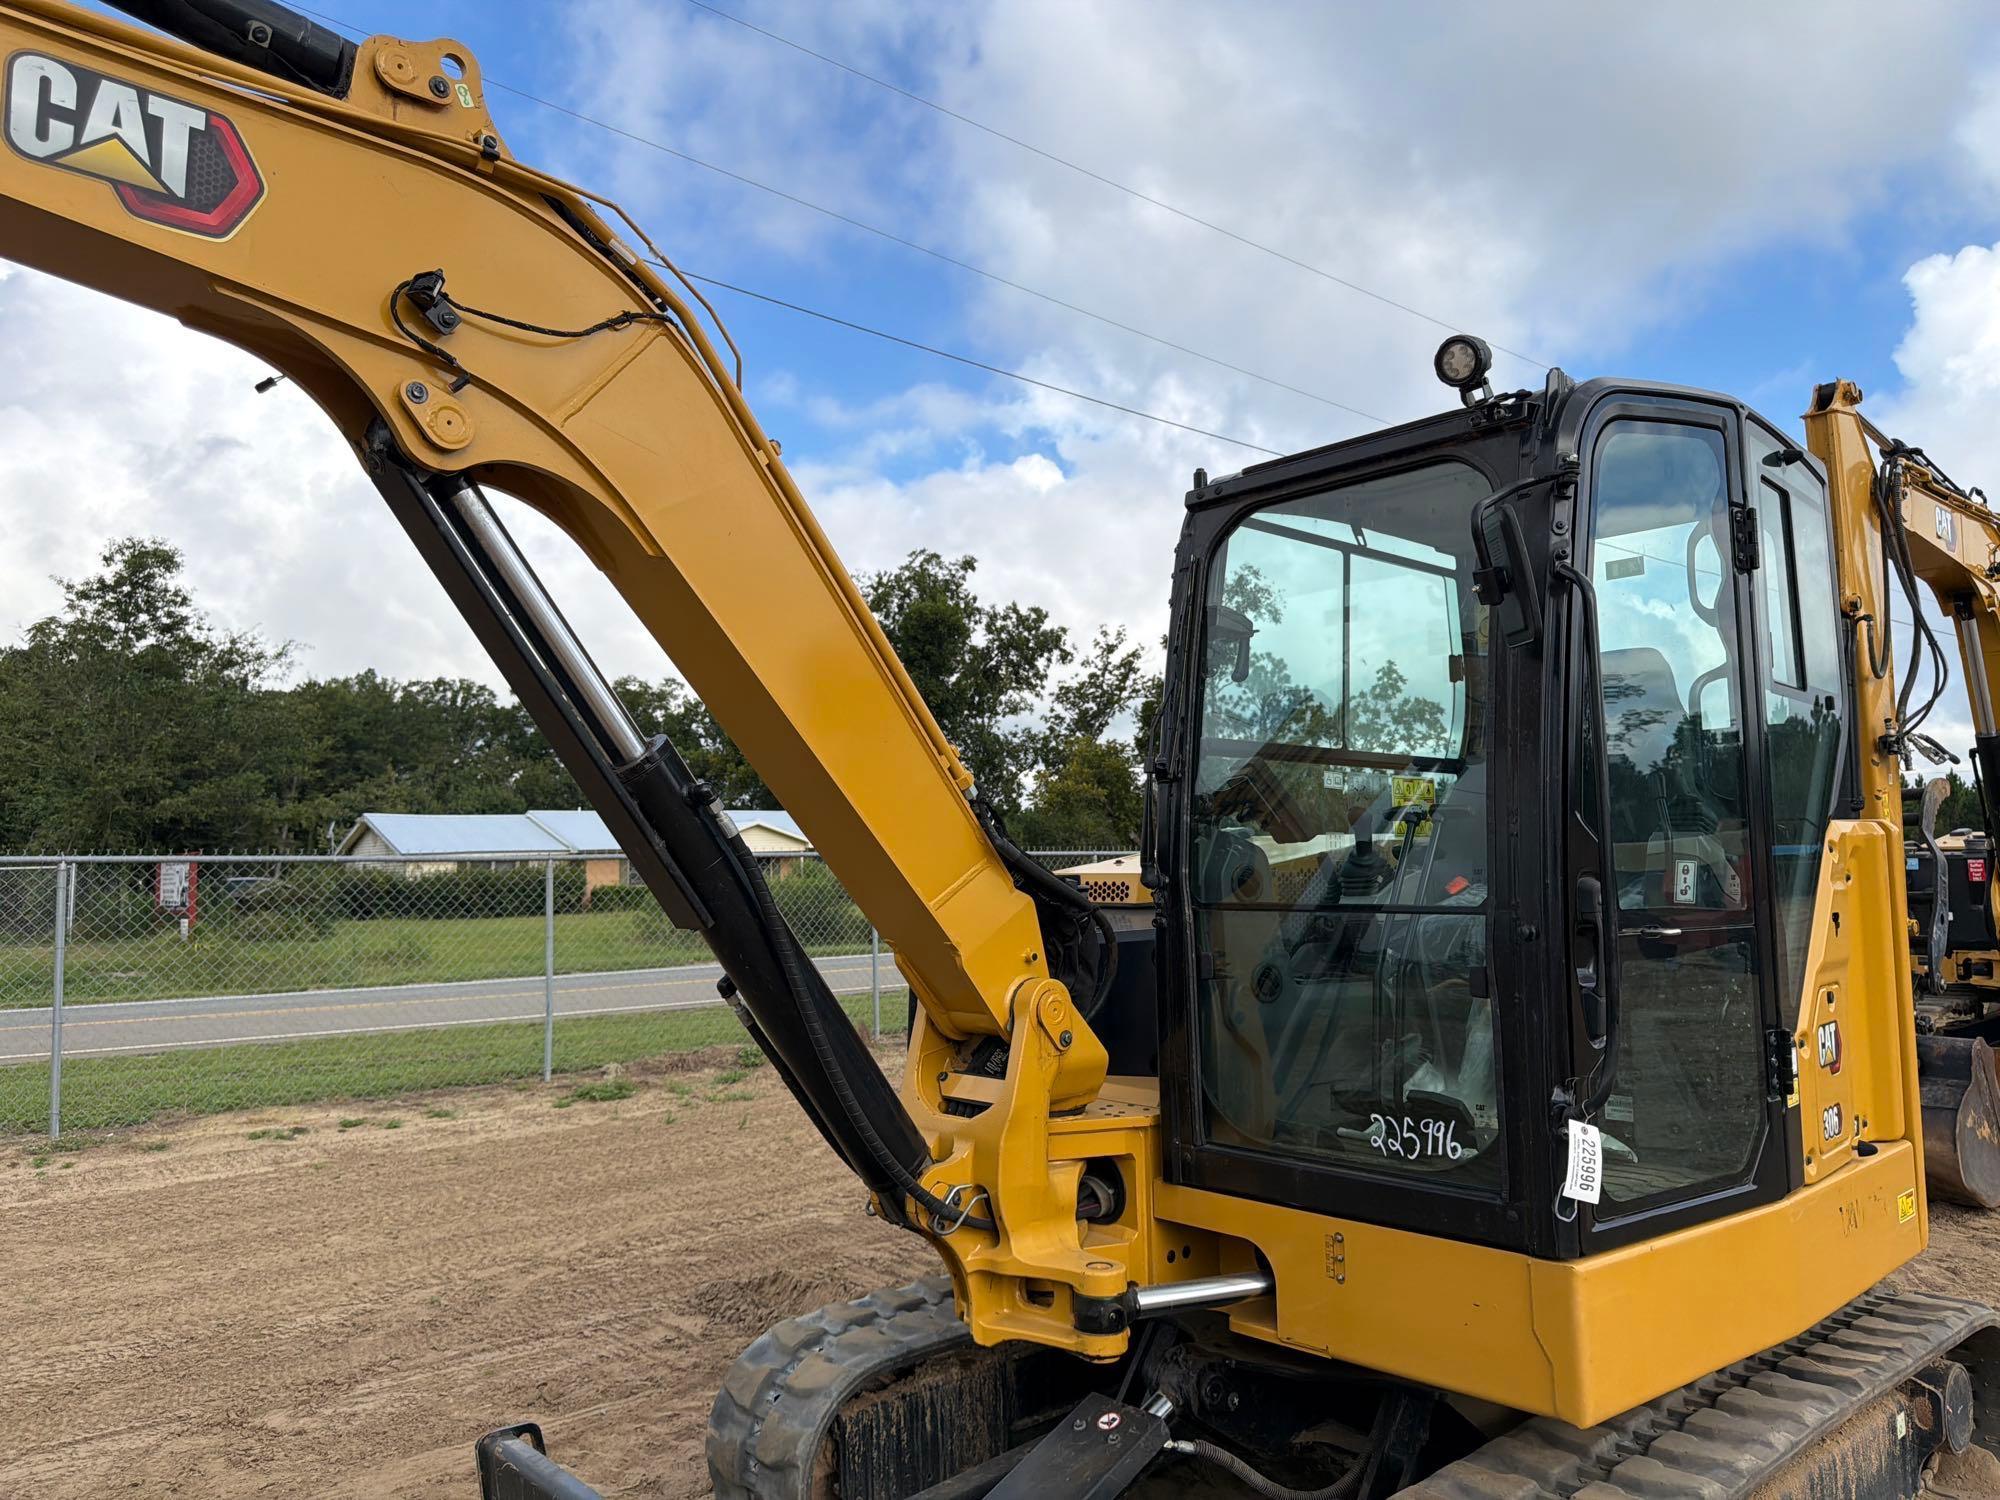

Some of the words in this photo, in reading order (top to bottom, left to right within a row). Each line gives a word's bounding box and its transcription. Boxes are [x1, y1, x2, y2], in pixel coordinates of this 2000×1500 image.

[10, 55, 206, 199] CAT
[1935, 505, 1952, 543] CAT
[1818, 1022, 1837, 1067] CAT
[1370, 1113, 1462, 1160] 225996
[1823, 1105, 1839, 1140] 306
[1579, 1138, 1596, 1192] 225996
